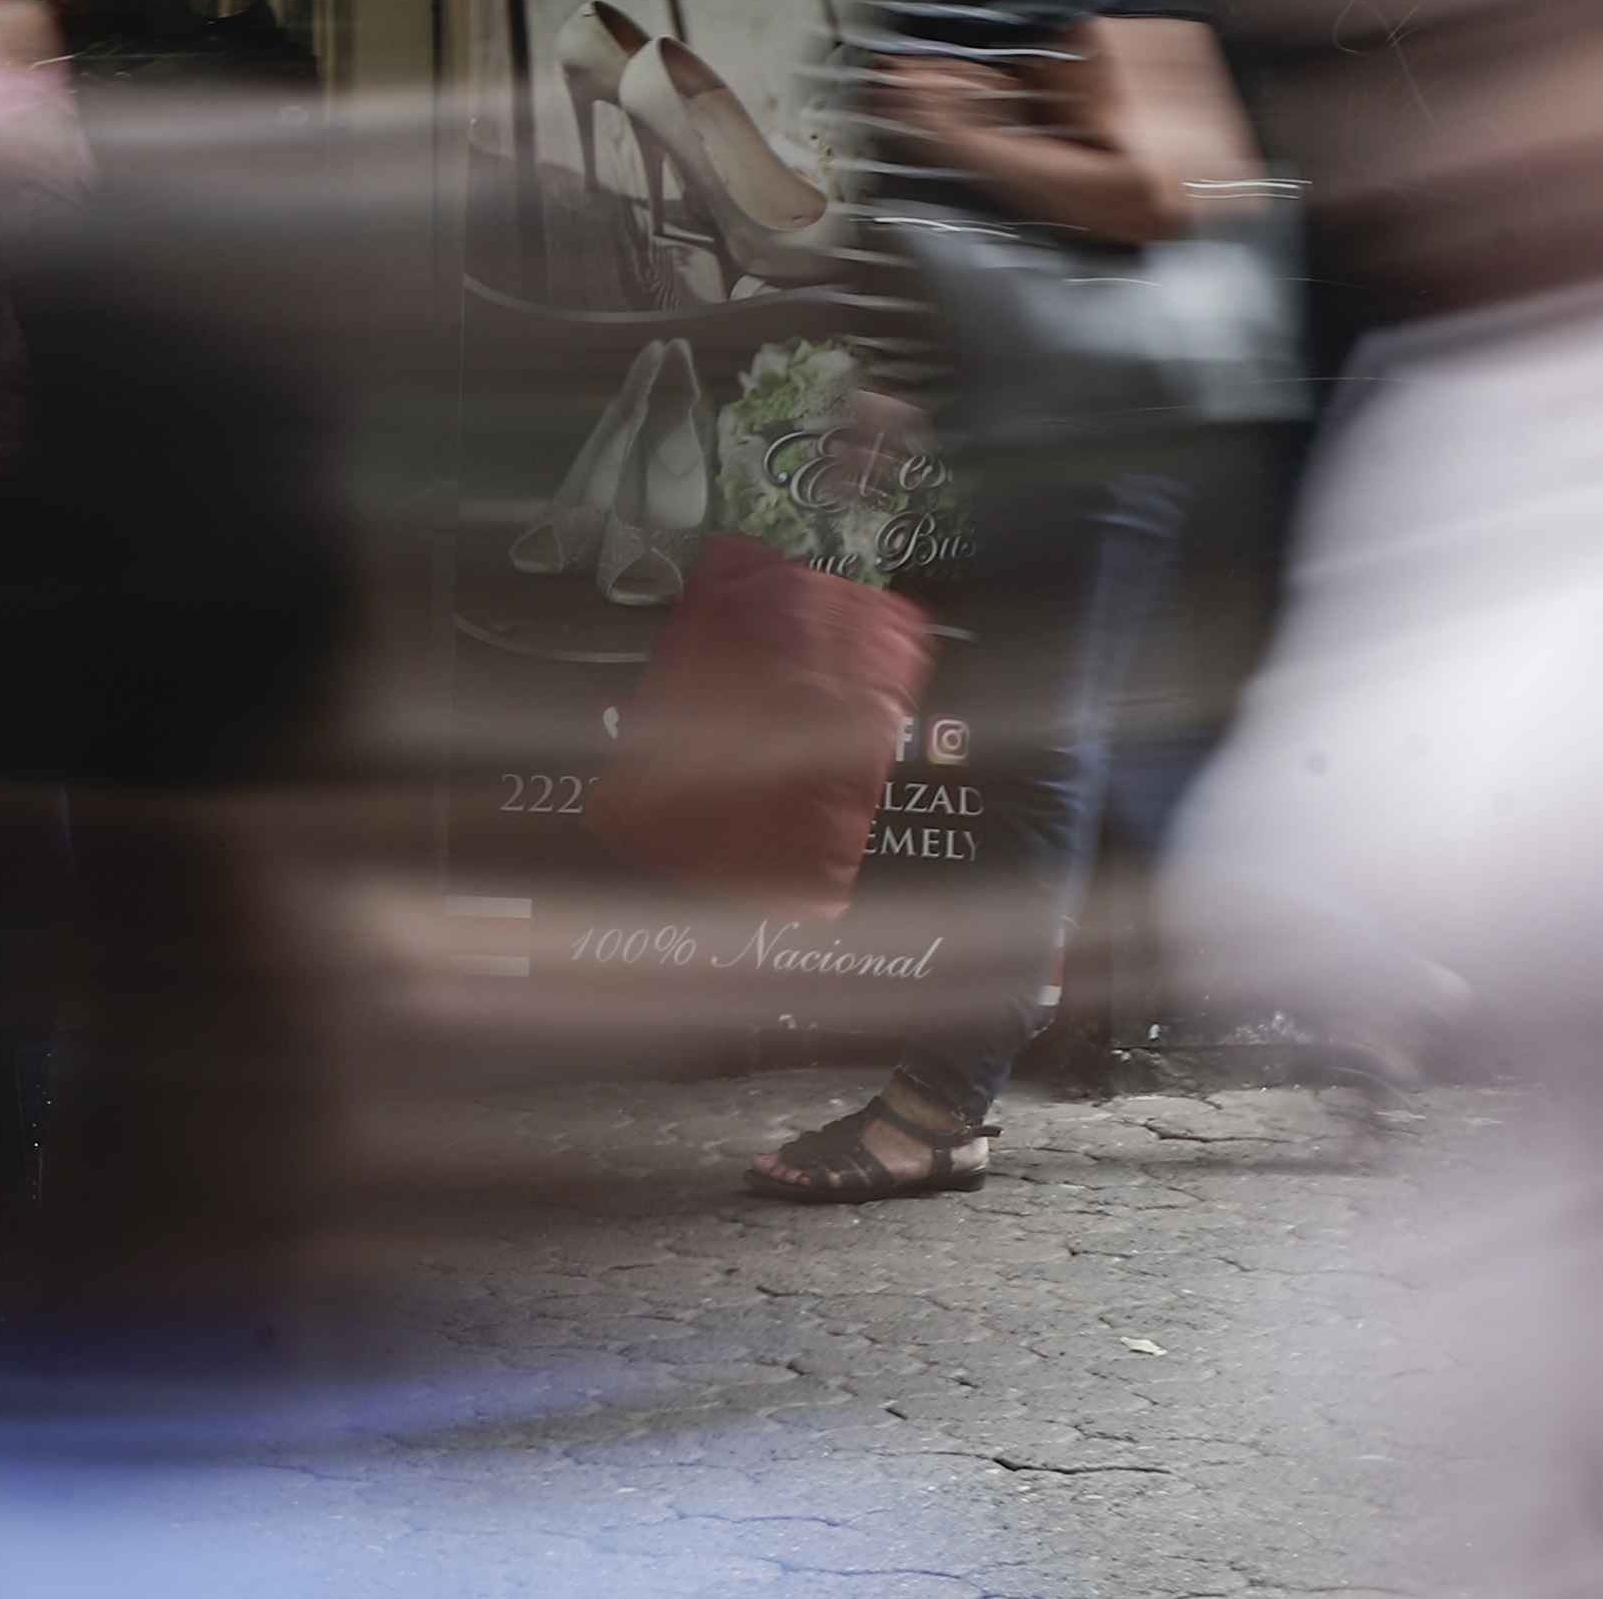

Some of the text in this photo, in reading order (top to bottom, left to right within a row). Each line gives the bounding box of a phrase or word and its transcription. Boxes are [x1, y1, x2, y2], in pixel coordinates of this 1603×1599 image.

[498, 772, 603, 814] 222
[570, 917, 945, 980] 100% Nacional
